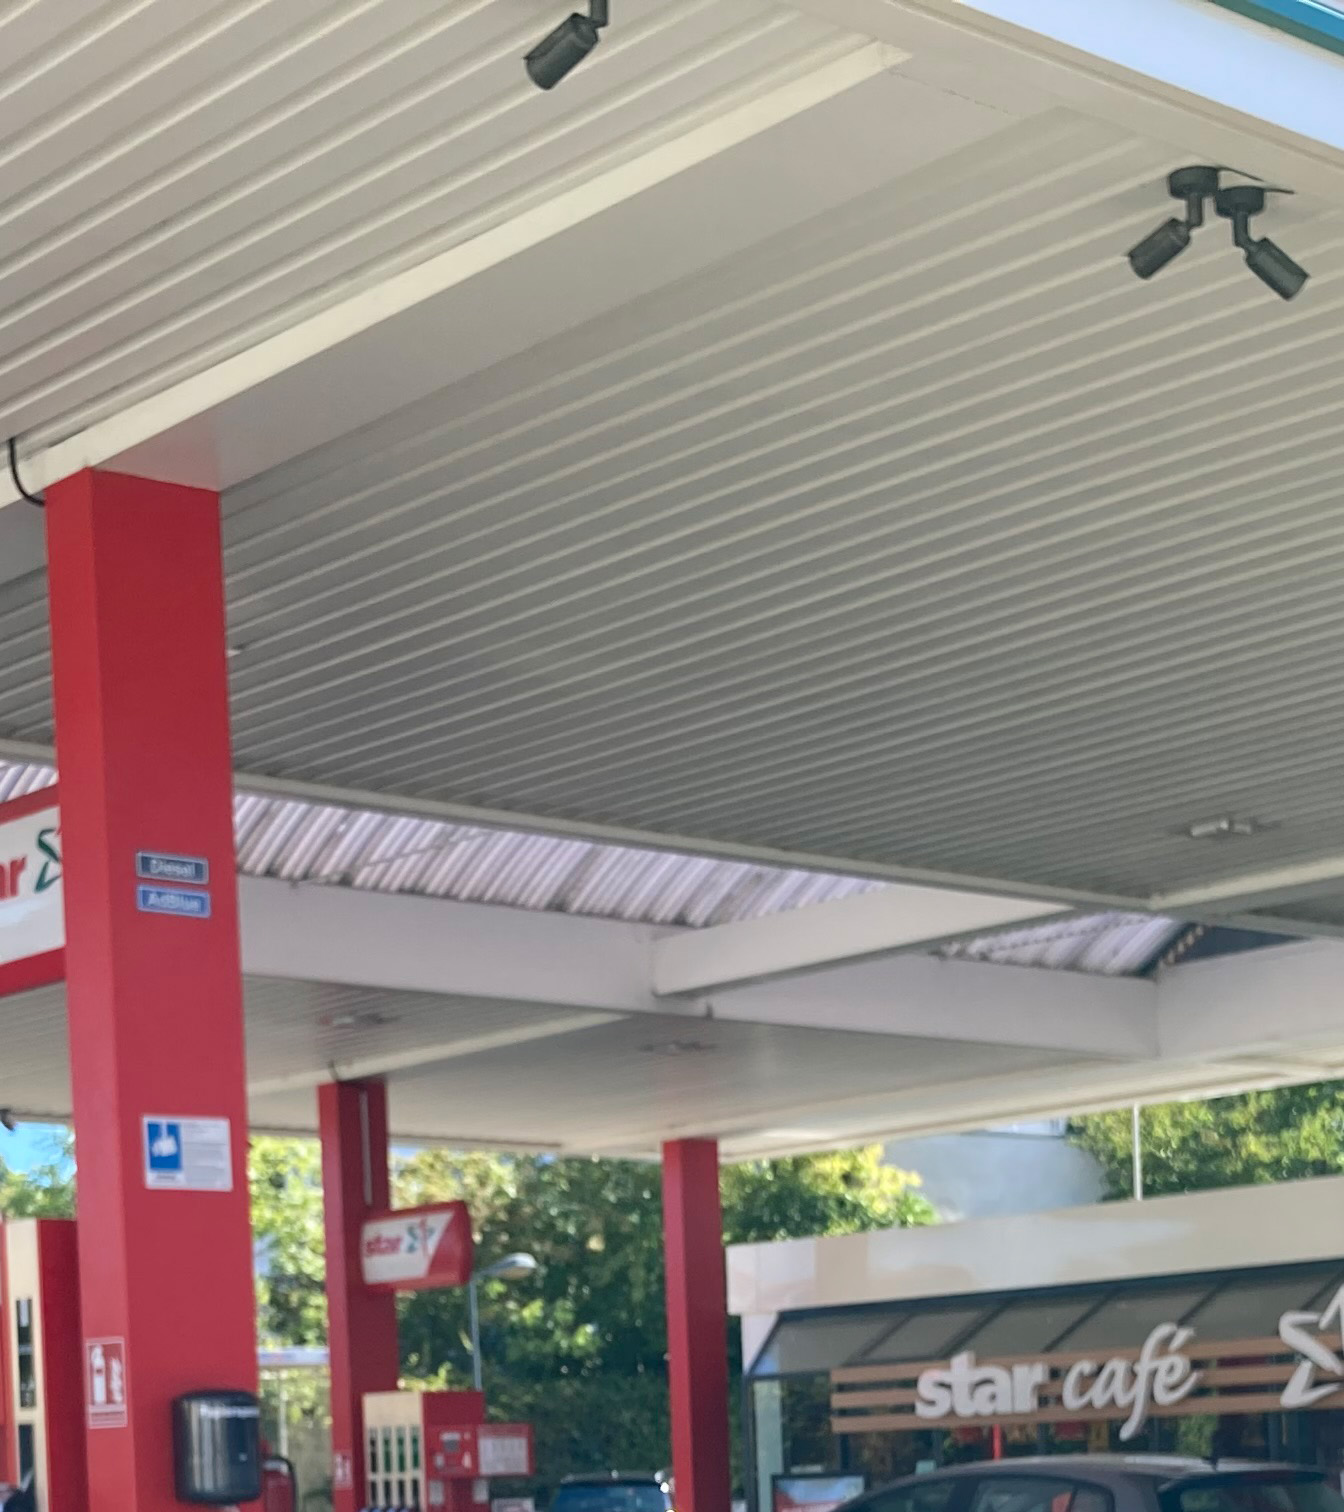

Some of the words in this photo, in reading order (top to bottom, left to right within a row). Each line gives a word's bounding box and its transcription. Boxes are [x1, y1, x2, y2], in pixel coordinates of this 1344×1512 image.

[364, 1232, 402, 1257] star
[914, 1350, 1049, 1418] star
[1062, 1322, 1204, 1441] café
